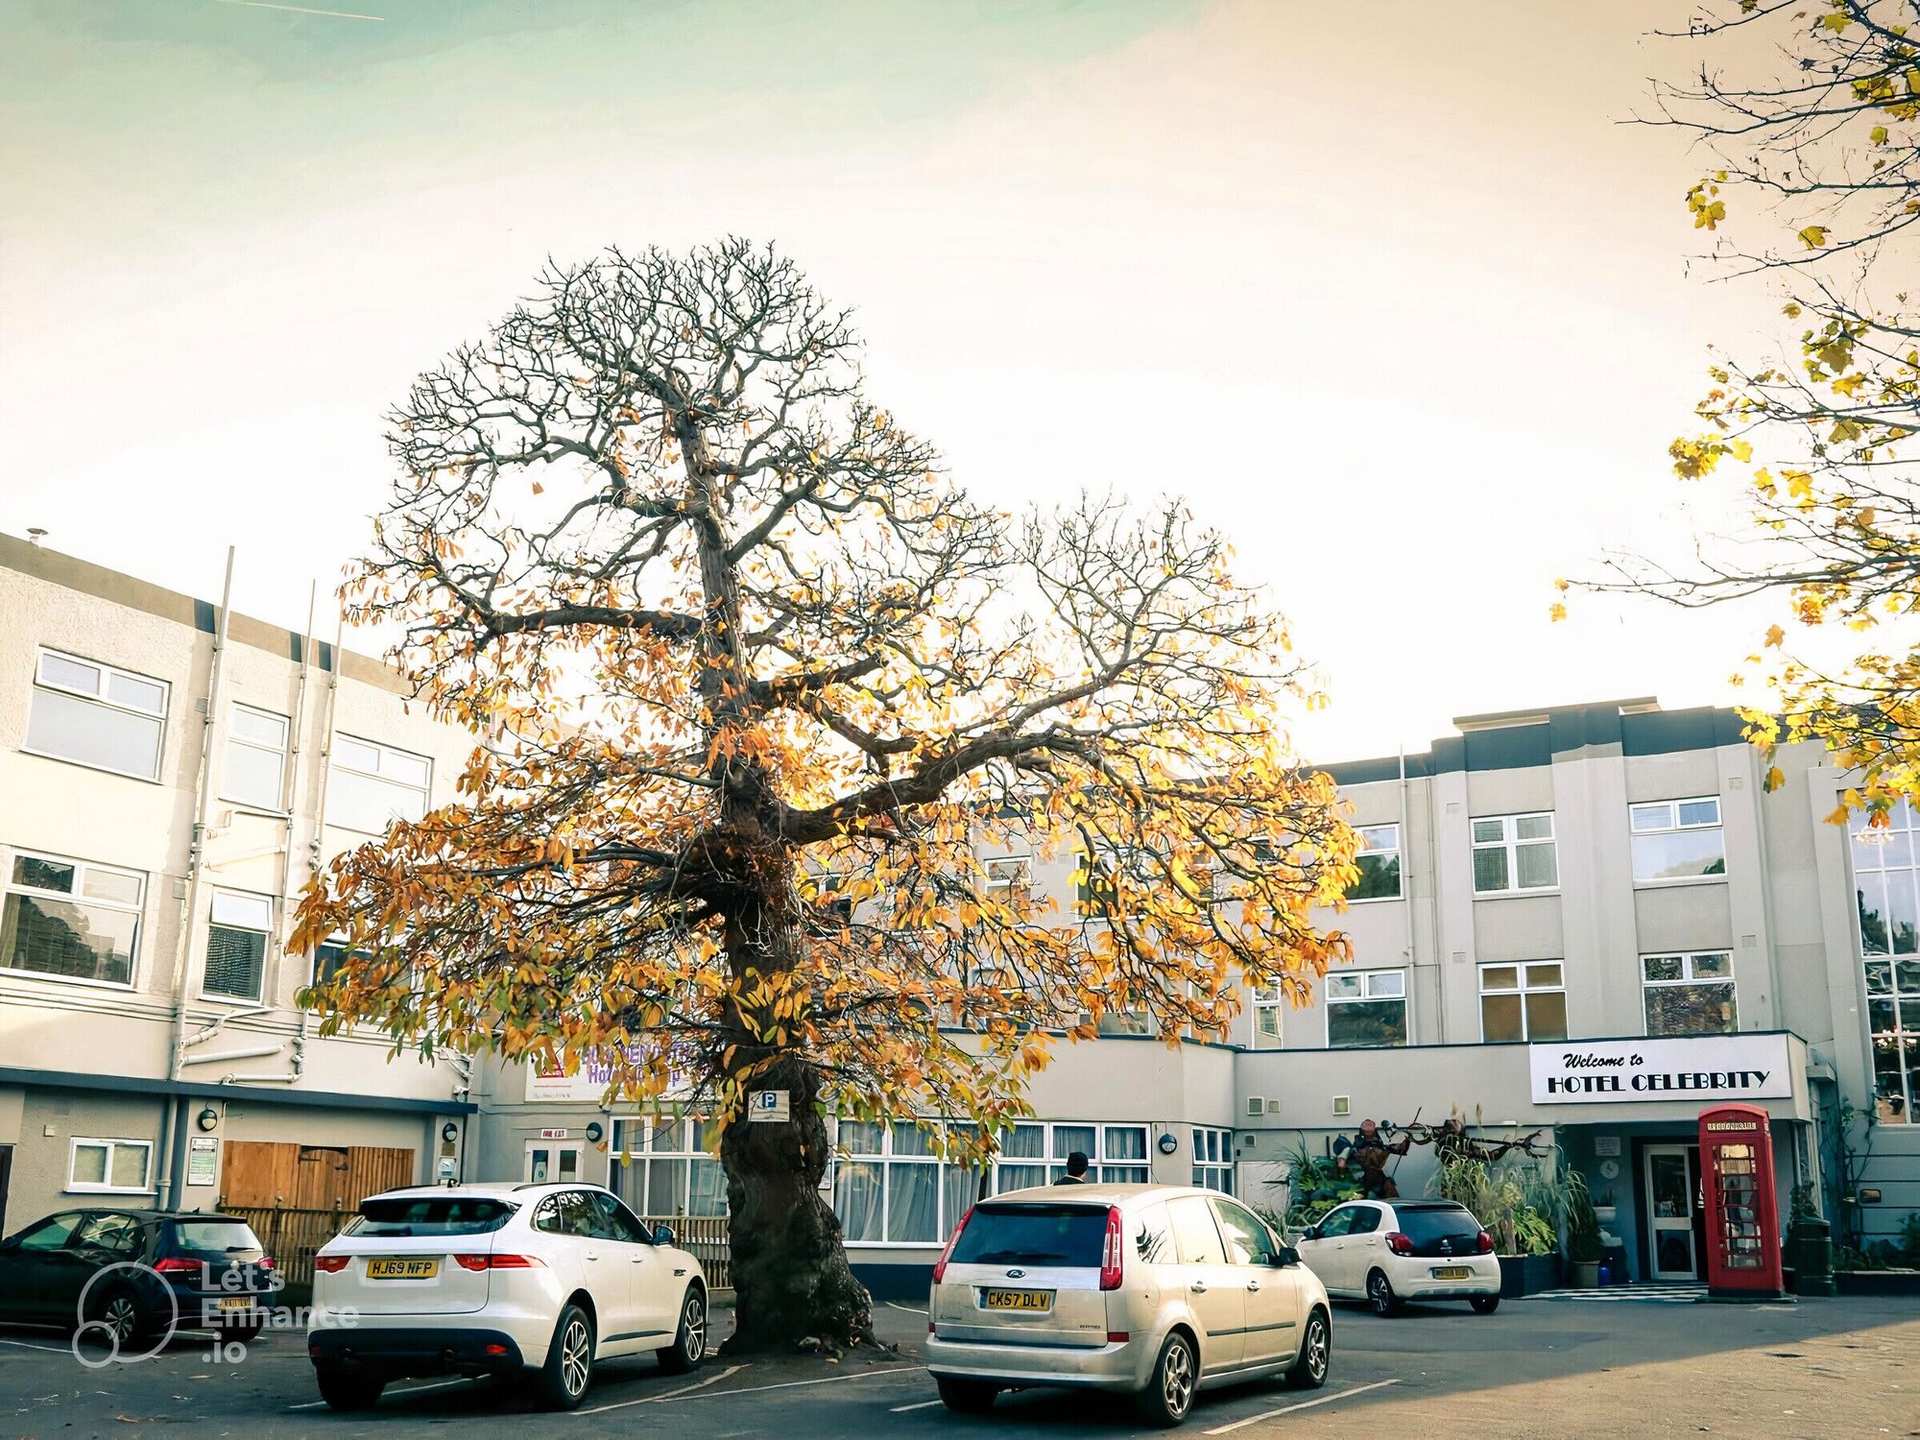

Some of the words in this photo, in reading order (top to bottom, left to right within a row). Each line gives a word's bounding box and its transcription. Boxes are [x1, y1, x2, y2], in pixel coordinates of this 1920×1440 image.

[1562, 1053, 1625, 1068] Welcome
[1630, 1053, 1644, 1066] to
[1548, 1075, 1627, 1093] HOTEL
[1631, 1071, 1770, 1092] CELEBRITY
[765, 1094, 775, 1107] P
[372, 1261, 405, 1274] HJ69
[1022, 1293, 1047, 1307] DLV
